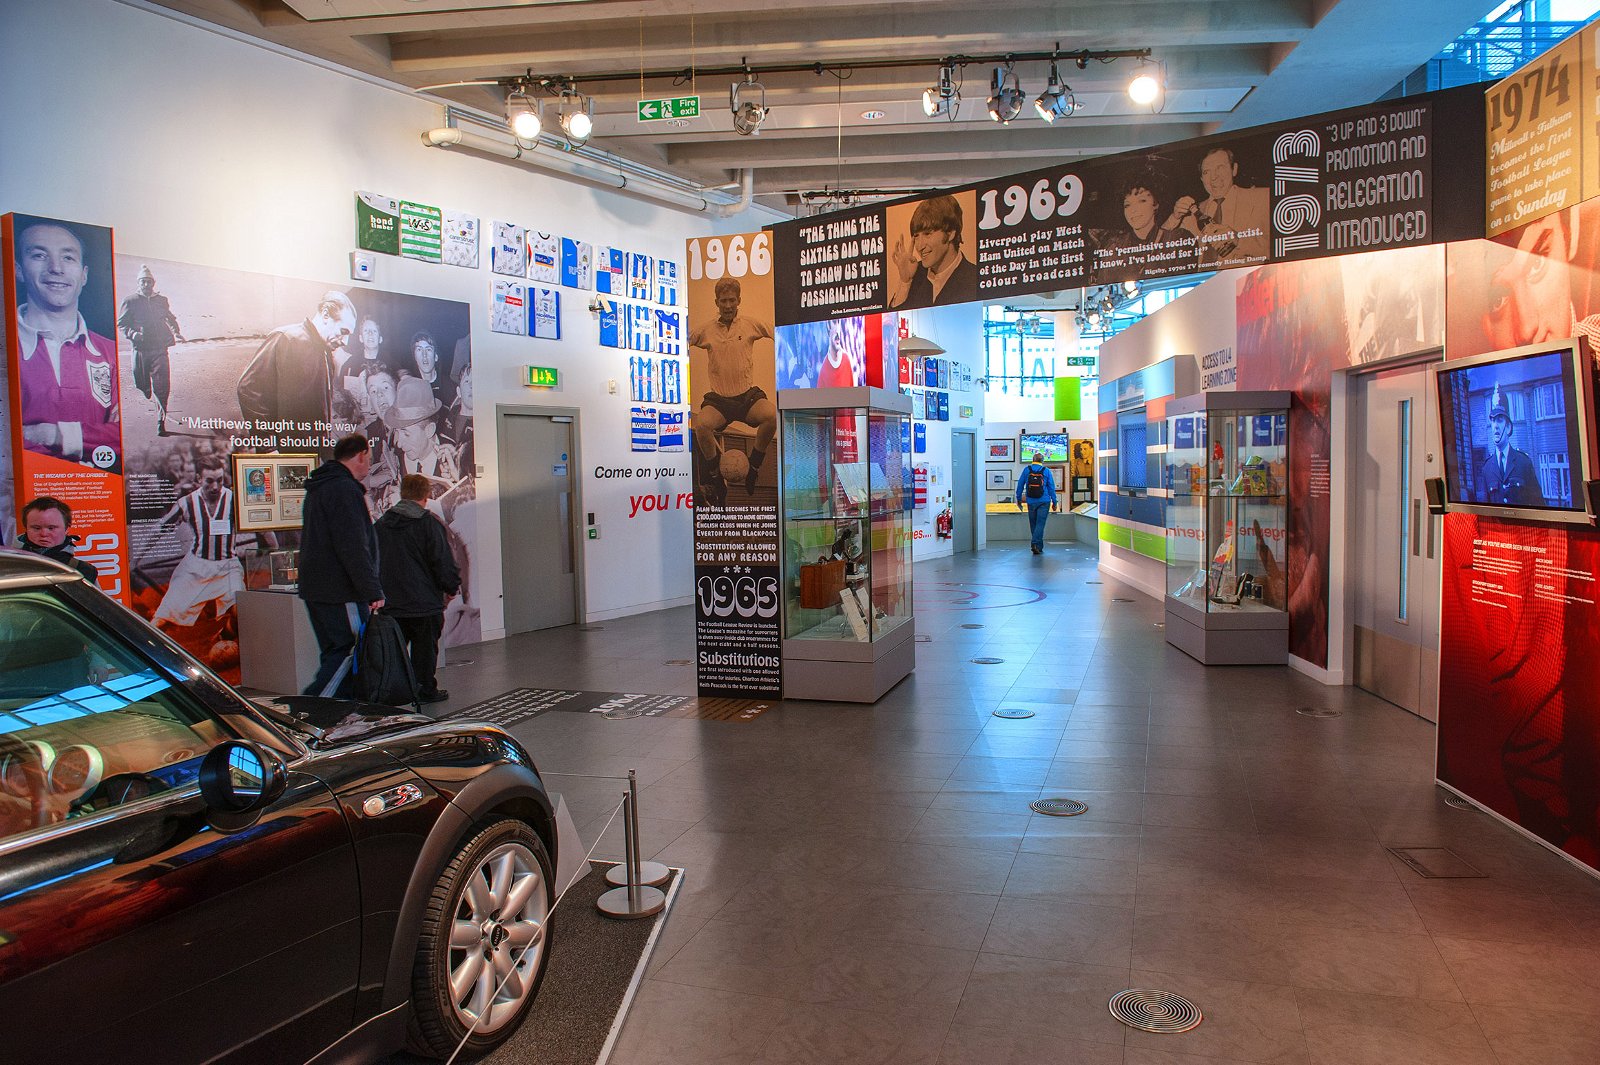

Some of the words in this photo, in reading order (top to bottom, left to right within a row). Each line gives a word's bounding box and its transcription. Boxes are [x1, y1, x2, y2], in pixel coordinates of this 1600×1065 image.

[1490, 54, 1570, 134] 1974
[1341, 121, 1354, 140] UP
[1357, 117, 1377, 137] AND
[1380, 115, 1387, 134] 3
[1490, 131, 1529, 159] Millwall
[1537, 112, 1572, 134] Fulham
[1326, 140, 1396, 172] PROMOTION
[1401, 135, 1426, 160] AND
[1490, 152, 1527, 176] becomes
[1530, 143, 1544, 156] the
[1548, 128, 1572, 151] first
[1490, 164, 1530, 192] Football
[1533, 148, 1572, 172] League
[1273, 129, 1320, 257] 1973
[1326, 170, 1423, 211] RELEGATION
[1490, 193, 1511, 211] game
[1514, 188, 1522, 198] to
[1525, 178, 1543, 193] take
[1545, 166, 1572, 188] place
[979, 174, 1083, 229] 1969
[1490, 218, 1502, 228] on
[1504, 214, 1511, 223] a
[1513, 188, 1567, 220] Sunday
[370, 215, 393, 226] bond
[371, 222, 394, 231] timber
[827, 219, 857, 240] THING
[860, 215, 880, 234] THE
[1326, 210, 1426, 250] INTRODUCED
[980, 233, 1027, 249] Liverpool
[1030, 230, 1052, 242] play
[1056, 224, 1082, 236] West
[1201, 231, 1234, 243] doesn't
[1237, 228, 1263, 239] exist.
[503, 245, 518, 255] Bury
[689, 233, 771, 279] 1966
[800, 244, 839, 266] SIXTIES
[841, 241, 859, 259] DID
[861, 236, 884, 255] WAS
[980, 252, 1001, 262] Ham
[1004, 245, 1035, 258] United
[1038, 245, 1050, 253] on
[1053, 238, 1085, 251] Match
[1100, 259, 1126, 268] know,
[1129, 256, 1144, 264] I've
[1147, 252, 1176, 262] looked
[1178, 249, 1192, 258] for
[1224, 257, 1246, 266] Rising
[1247, 254, 1266, 263] Damp
[801, 270, 812, 286] TO
[815, 266, 842, 284] SHOW
[845, 262, 857, 280] US
[860, 259, 880, 277] THE
[980, 266, 989, 275] of
[992, 264, 1007, 274] the
[1009, 261, 1027, 272] Day
[1029, 259, 1039, 268] in
[1042, 256, 1058, 267] the
[1061, 252, 1084, 264] first
[980, 276, 1018, 288] colour
[1023, 266, 1084, 283] broadcast
[1202, 351, 1218, 370] ACCESS
[1220, 350, 1226, 365] TO
[1202, 371, 1223, 390] LEARNING
[1224, 366, 1236, 385] ZONE
[255, 419, 294, 432] taught
[298, 422, 311, 431] us
[314, 420, 332, 431] the
[335, 423, 357, 434] way
[230, 435, 277, 447] football
[280, 435, 319, 447] should
[322, 436, 336, 447] be
[95, 451, 113, 462] 125
[595, 466, 632, 478] Come
[636, 467, 651, 477] on
[654, 467, 675, 480] you
[629, 494, 669, 518] you
[718, 553, 736, 561] ANY
[741, 553, 776, 561] REASON
[698, 576, 777, 617] 1965
[700, 651, 779, 667] Substitutions
